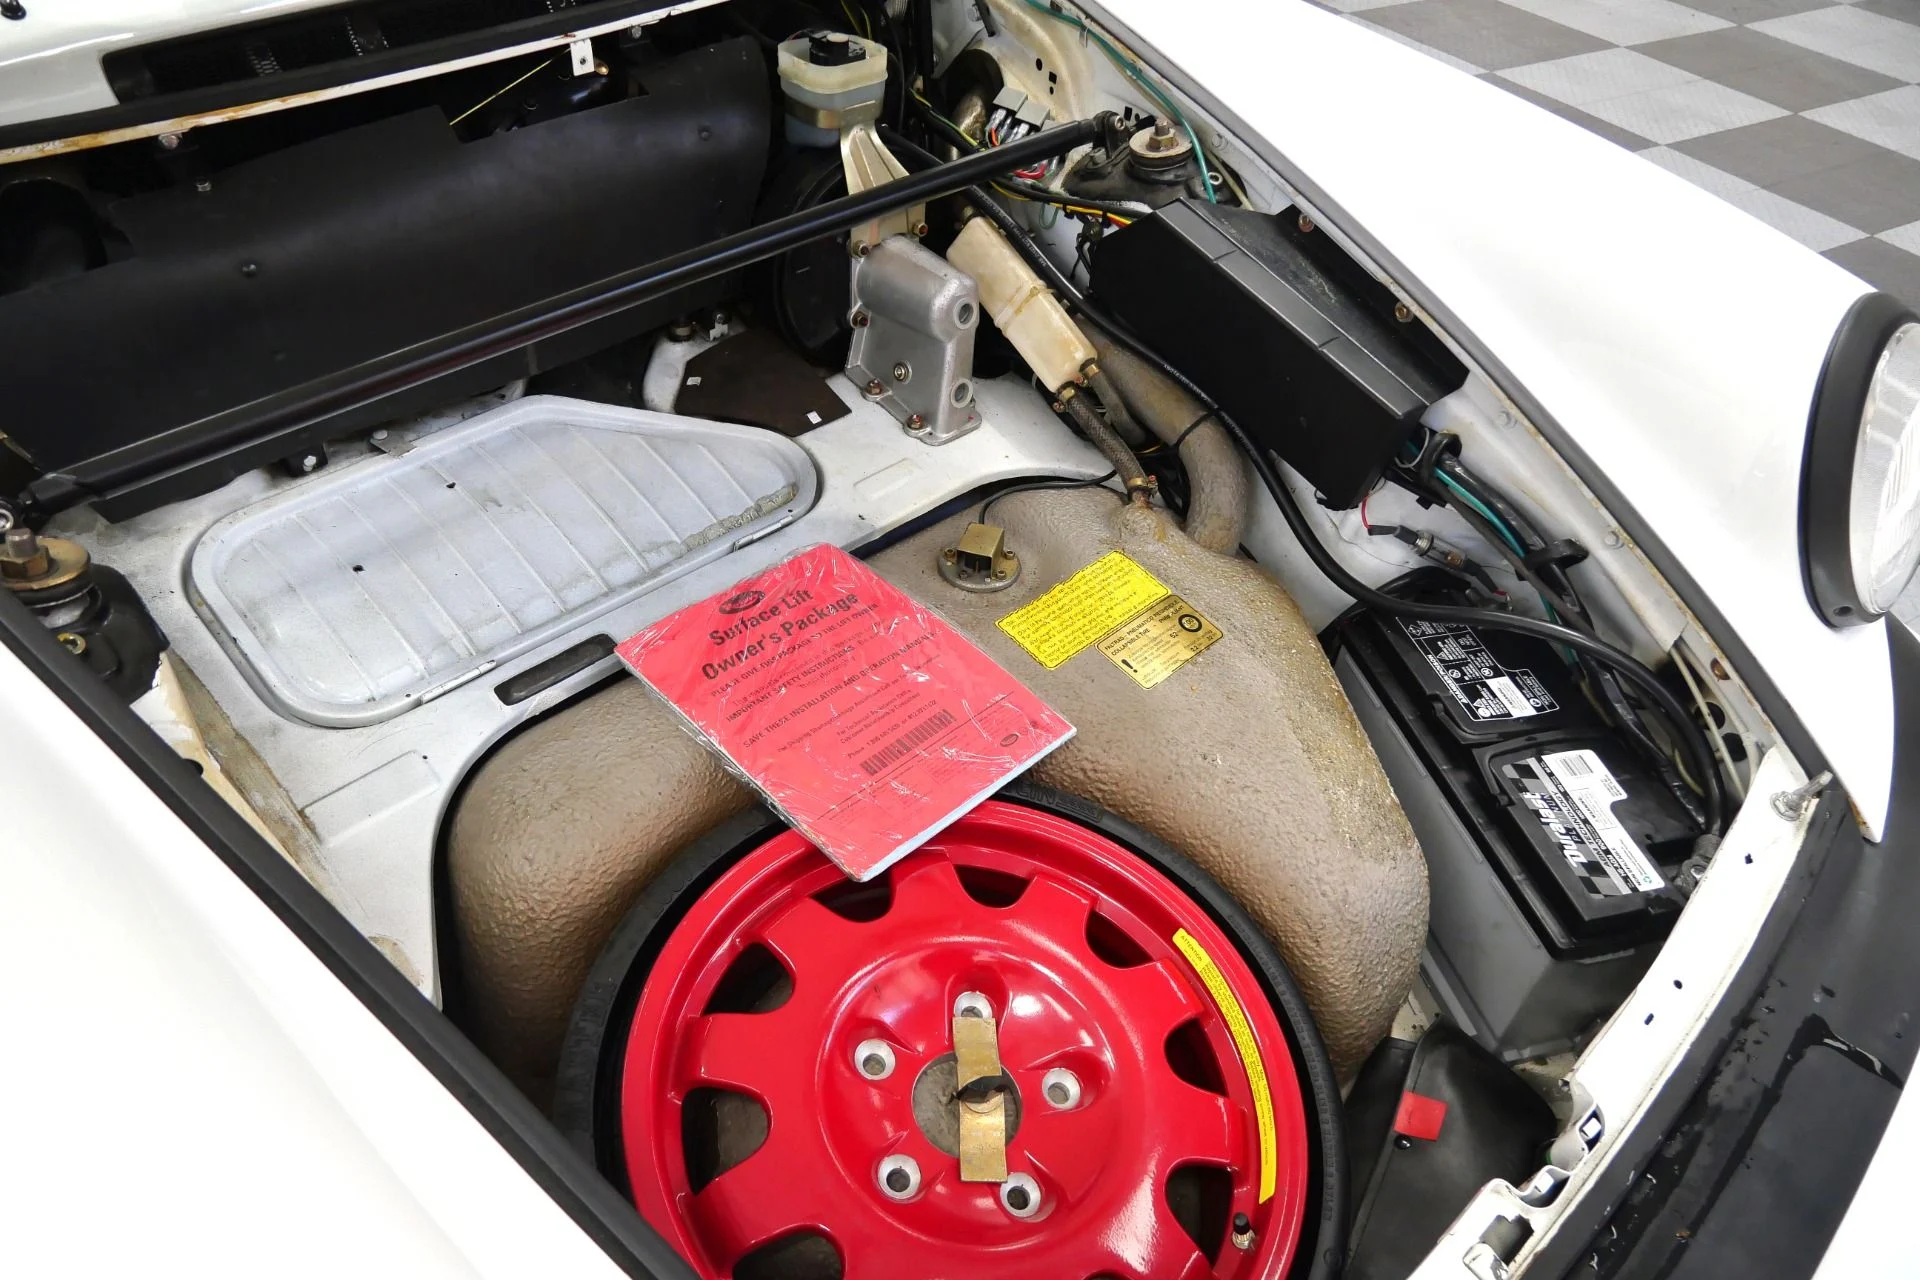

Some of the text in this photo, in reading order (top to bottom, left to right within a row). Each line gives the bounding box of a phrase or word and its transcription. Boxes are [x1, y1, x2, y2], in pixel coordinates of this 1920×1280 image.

[702, 633, 780, 678] Owner's
[781, 594, 856, 635] Package
[710, 606, 780, 645] Surface
[781, 590, 813, 608] Lift
[1126, 617, 1153, 637] PNEUMATICO
[711, 678, 740, 696] PLEASE
[740, 666, 758, 679] GIVE
[778, 639, 810, 658] PACKAGE
[1111, 635, 1140, 655] COLLAPSIBLE
[727, 692, 771, 720] IMPORTANT
[772, 674, 800, 693] SAFETY
[743, 732, 764, 747] SAVE
[764, 716, 790, 732] THESE
[789, 684, 842, 716] INSTALLATION
[843, 675, 859, 686] AND
[859, 652, 899, 676] OPERATION
[1524, 792, 1585, 867] Duralast
[1541, 790, 1579, 840] PLATINUM
[1552, 791, 1593, 844] TECHNOLOGY
[1592, 847, 1610, 867] AGM
[1181, 935, 1201, 961] ATTENTION
